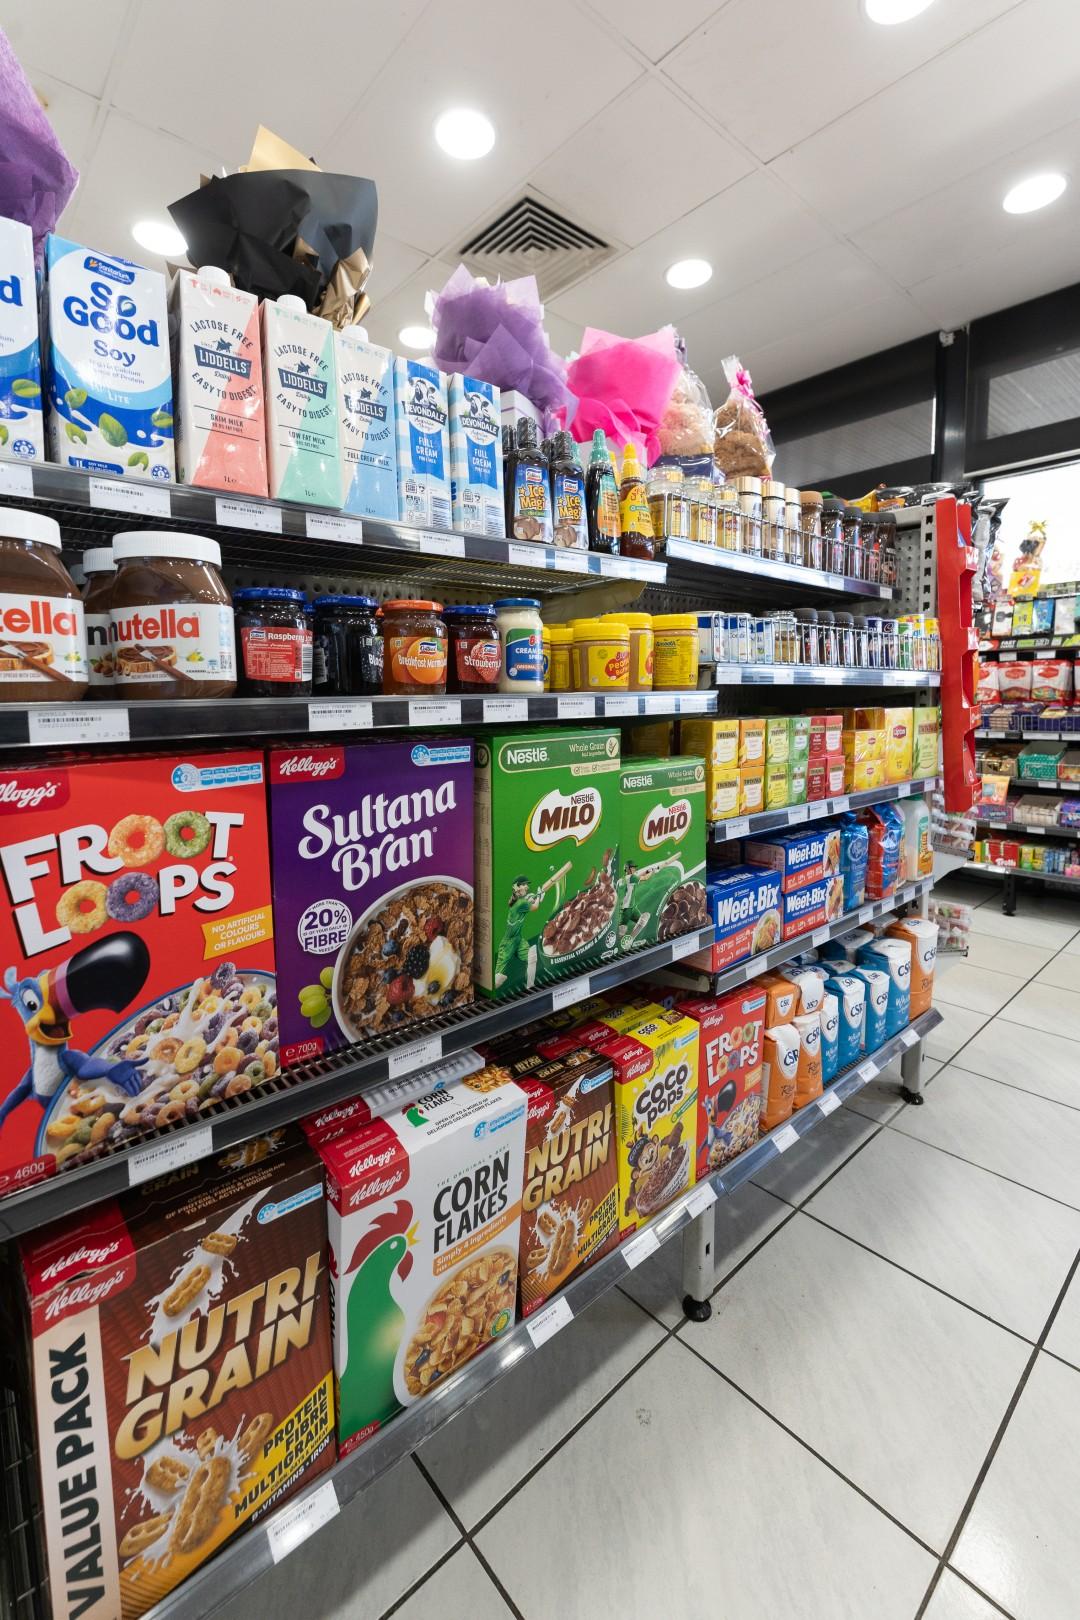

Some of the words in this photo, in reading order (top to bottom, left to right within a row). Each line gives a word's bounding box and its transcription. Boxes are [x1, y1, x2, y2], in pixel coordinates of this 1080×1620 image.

[90, 281, 137, 317] So
[63, 295, 160, 347] Good
[190, 320, 228, 333] LACTOSE
[231, 329, 254, 349] FREE
[94, 339, 136, 367] Soy
[199, 351, 249, 373] LIDDELLS
[274, 344, 306, 357] LACTOSE
[310, 353, 328, 371] FREE
[192, 372, 214, 393] EASY
[217, 388, 226, 399] TO
[229, 385, 257, 401] DIGEST
[283, 372, 324, 394] LIDDELLS
[341, 372, 368, 384] LACTOSE
[371, 380, 388, 396] FREE
[276, 393, 296, 412] EASY
[299, 408, 307, 417] TO
[310, 404, 332, 419] DIGEST
[210, 413, 226, 424] SKIM
[228, 418, 244, 428] MILK
[342, 418, 360, 436] EASY
[361, 431, 369, 440] TO
[371, 427, 392, 441] DIGEST
[462, 417, 497, 434] DEVONDALE
[313, 436, 326, 445] MILK
[416, 446, 437, 458] CREAM
[418, 437, 434, 447] FULL
[472, 456, 491, 468] CREAM
[474, 449, 488, 459] FULL
[528, 484, 545, 497] Ice
[566, 495, 580, 507] Ice
[0, 601, 77, 636] ella
[109, 609, 199, 642] nutella
[268, 632, 304, 642] Raspberry
[398, 655, 426, 669] Breakfast
[507, 746, 548, 764] Nestlé
[569, 743, 589, 753] Whole
[590, 742, 605, 750] Grain
[280, 756, 337, 777] Kellogg's
[623, 775, 653, 788] Nestlé
[570, 793, 595, 805] Nestlé
[668, 803, 686, 815] Nestlé
[298, 781, 456, 860] Sultana
[538, 803, 595, 834] MILO
[646, 812, 688, 840] MILO
[0, 811, 244, 904] FROOT
[332, 829, 433, 891] Bran
[788, 841, 824, 865] Weet-Bix
[14, 862, 238, 957] LOOPS
[718, 884, 780, 927] Weet-Bix
[787, 884, 826, 913] Weet-Bix
[212, 924, 225, 933] NO
[227, 912, 265, 930] ARTIFICIAL
[220, 921, 260, 940] COLOURS
[305, 909, 347, 930] 20%
[214, 942, 226, 951] OR
[228, 928, 266, 947] FLAVOURS
[305, 930, 346, 950] FIBRE
[298, 1042, 317, 1054] 700g
[623, 1047, 644, 1060] Kellogg's
[706, 1020, 762, 1066] FROOT
[626, 1059, 650, 1078] Kellogg's
[708, 1042, 759, 1087] LOOPS
[784, 1049, 798, 1066] CSR
[418, 1088, 449, 1104] CORN
[424, 1095, 454, 1111] FLAKES
[315, 1103, 359, 1127] Kellogg's
[427, 1121, 453, 1136] DELICIOUS
[485, 1096, 502, 1108] FLAKES
[435, 1117, 448, 1126] OPEN
[526, 1103, 615, 1180] NUTRI
[14, 1161, 45, 1179] 460g
[349, 1146, 396, 1178] Kellogg's
[522, 1131, 611, 1211] GRAIN
[186, 1206, 198, 1215] TO
[199, 1198, 217, 1210] FUEL
[219, 1185, 245, 1200] ACTIVE
[246, 1173, 273, 1188] BODIES
[350, 1170, 402, 1207] Kellogg's
[433, 1150, 510, 1222] CORN
[433, 1184, 508, 1254] FLAKES
[590, 1189, 616, 1226] PROTEIN
[599, 1200, 616, 1225] FIBRE
[41, 1241, 119, 1281] Kellogg's
[436, 1247, 461, 1265] Simply
[44, 1269, 125, 1321] Kellogg's
[120, 1251, 326, 1405] NUTRI
[115, 1299, 314, 1460] GRAIN
[50, 1332, 94, 1468] PACK
[264, 1380, 327, 1459] PROTEIN
[285, 1399, 328, 1452] FIBRE
[310, 1436, 330, 1462] IRON
[234, 1412, 329, 1519] MULTIGRAIN
[59, 1466, 105, 1620] VALUE
